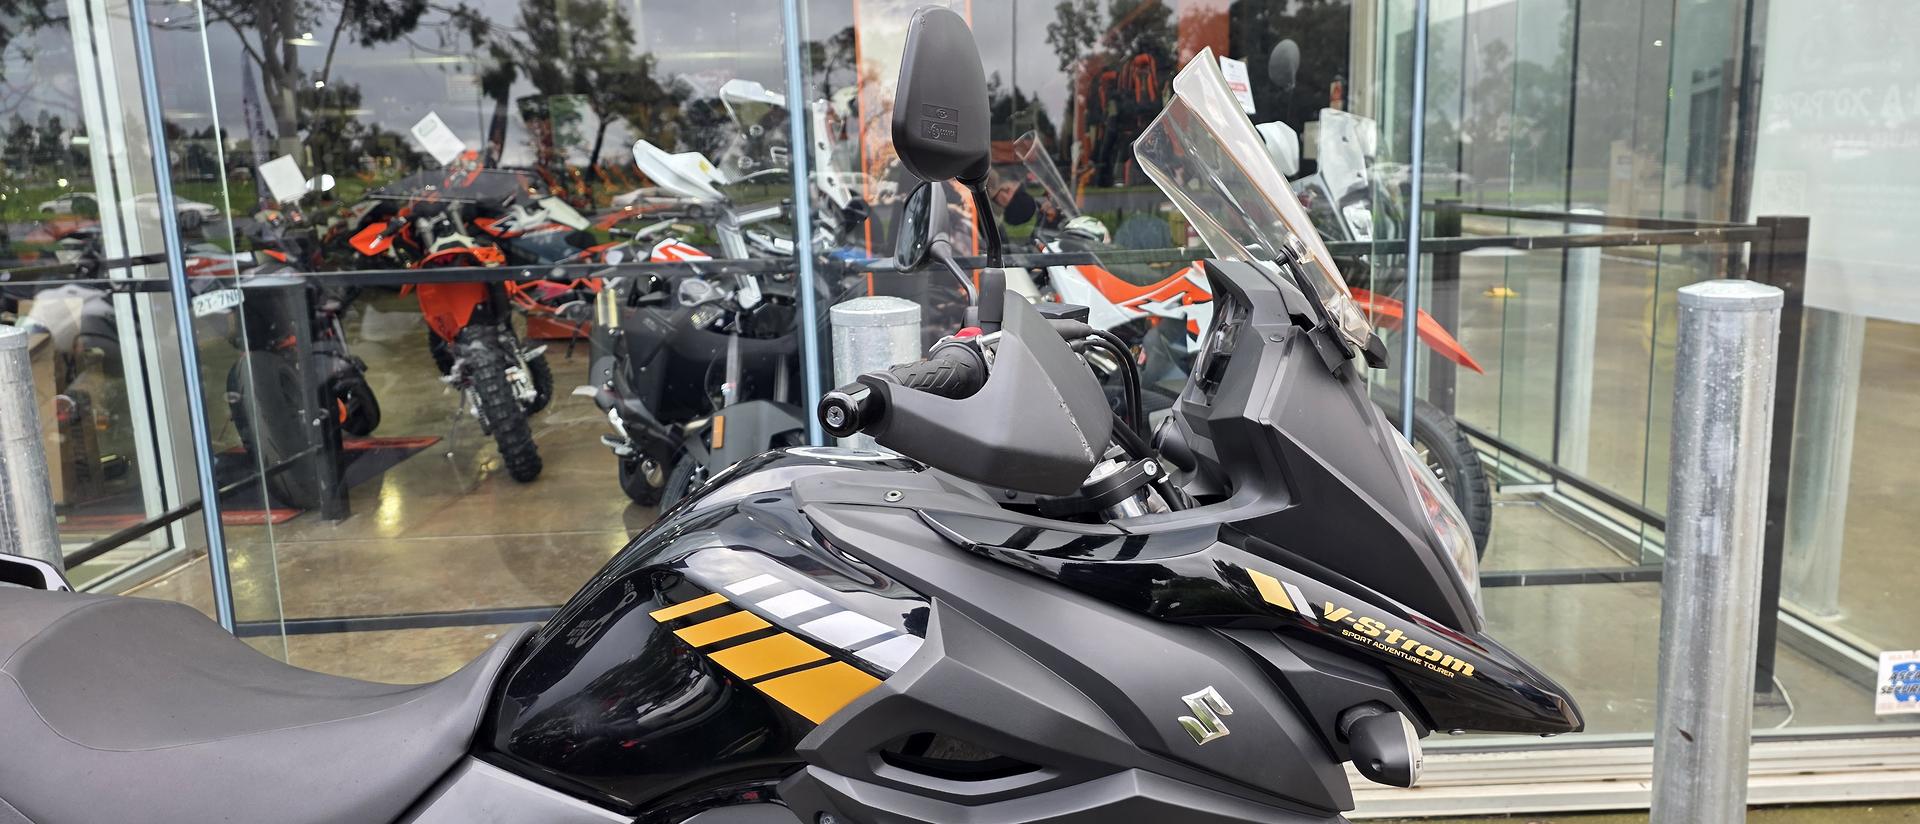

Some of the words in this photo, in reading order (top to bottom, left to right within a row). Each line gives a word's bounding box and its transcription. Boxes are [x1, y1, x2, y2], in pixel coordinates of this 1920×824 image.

[1324, 601, 1474, 676] V-Strom
[1342, 629, 1372, 645] SPORT
[1373, 641, 1422, 665] ADVENTURE
[1423, 660, 1455, 678] TOURER
